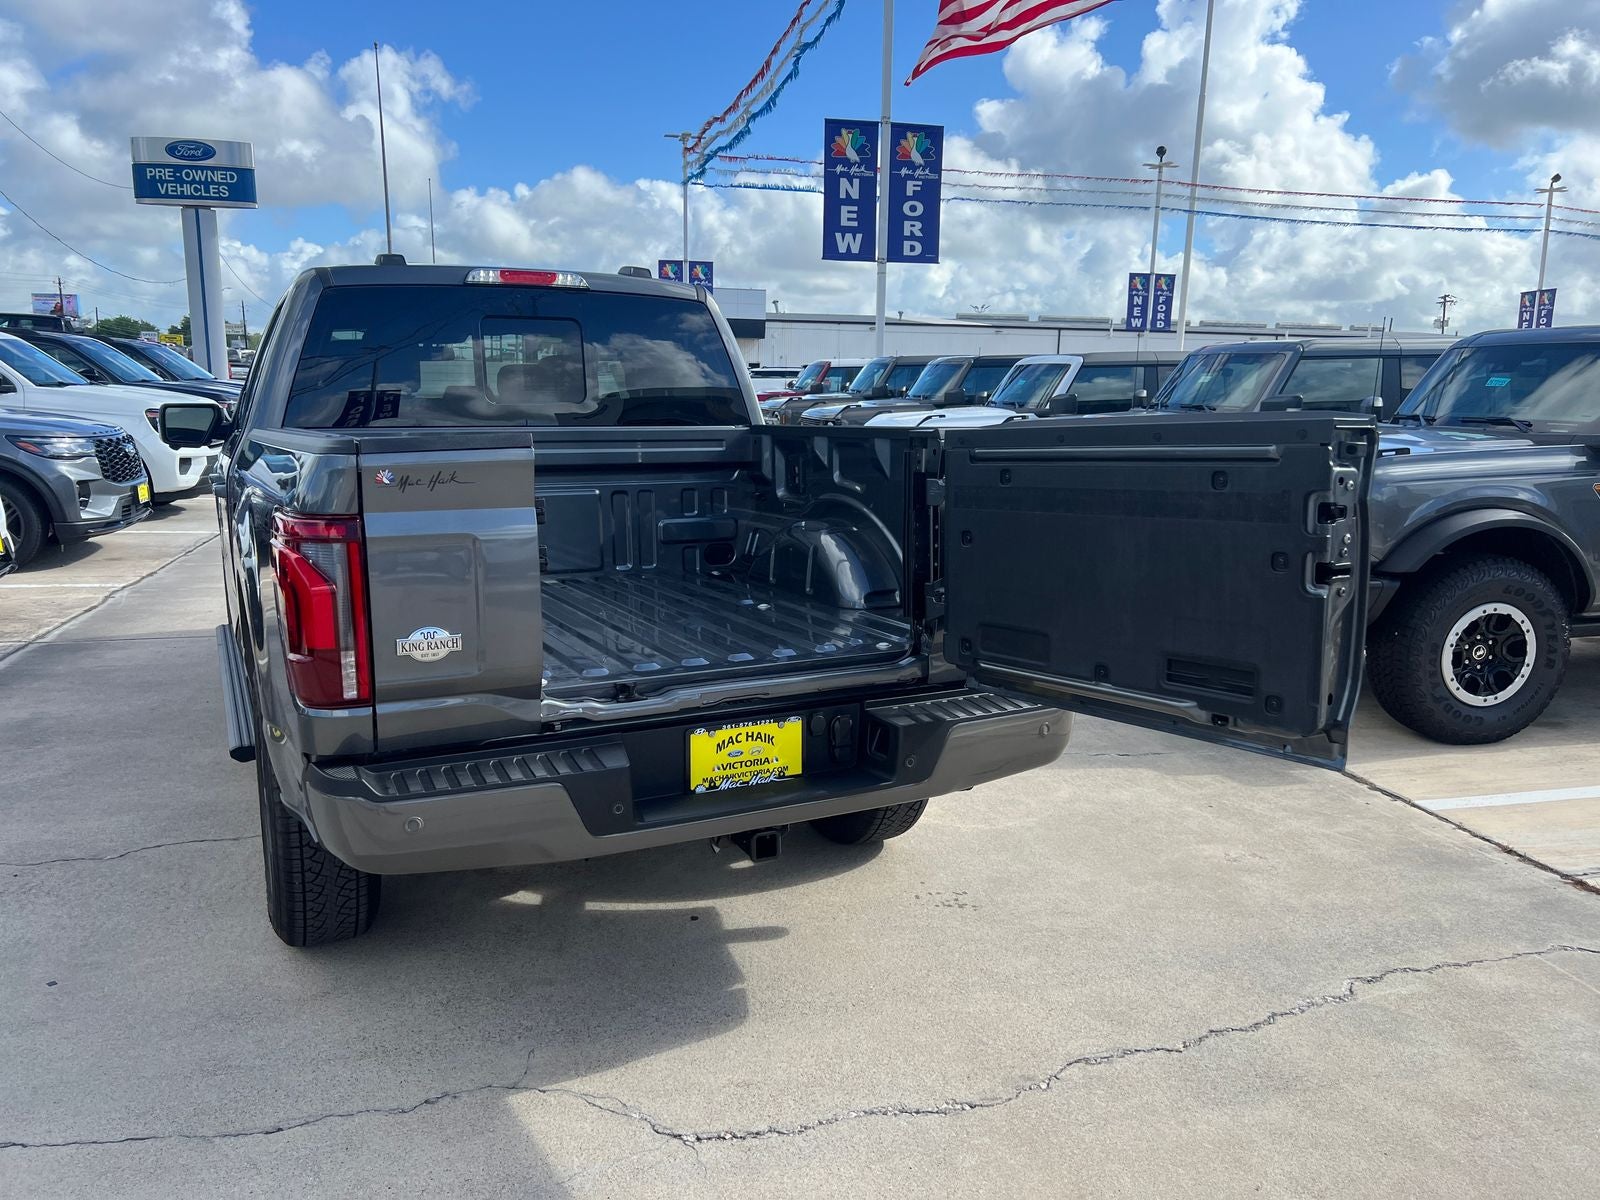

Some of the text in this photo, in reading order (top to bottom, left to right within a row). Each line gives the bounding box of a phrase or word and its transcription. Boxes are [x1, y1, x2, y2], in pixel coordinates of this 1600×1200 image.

[175, 144, 204, 157] Ford
[157, 183, 230, 197] VEHICLES
[835, 178, 863, 254] NEW
[902, 180, 924, 256] FORD
[1131, 296, 1143, 328] NEW
[1156, 296, 1167, 328] FORD
[396, 470, 468, 493] Mac Haik
[401, 637, 458, 653] KING RANCH
[716, 731, 775, 754] MAC HAIK
[721, 757, 770, 771] VICTORIA
[718, 772, 781, 791] Mac Haik
